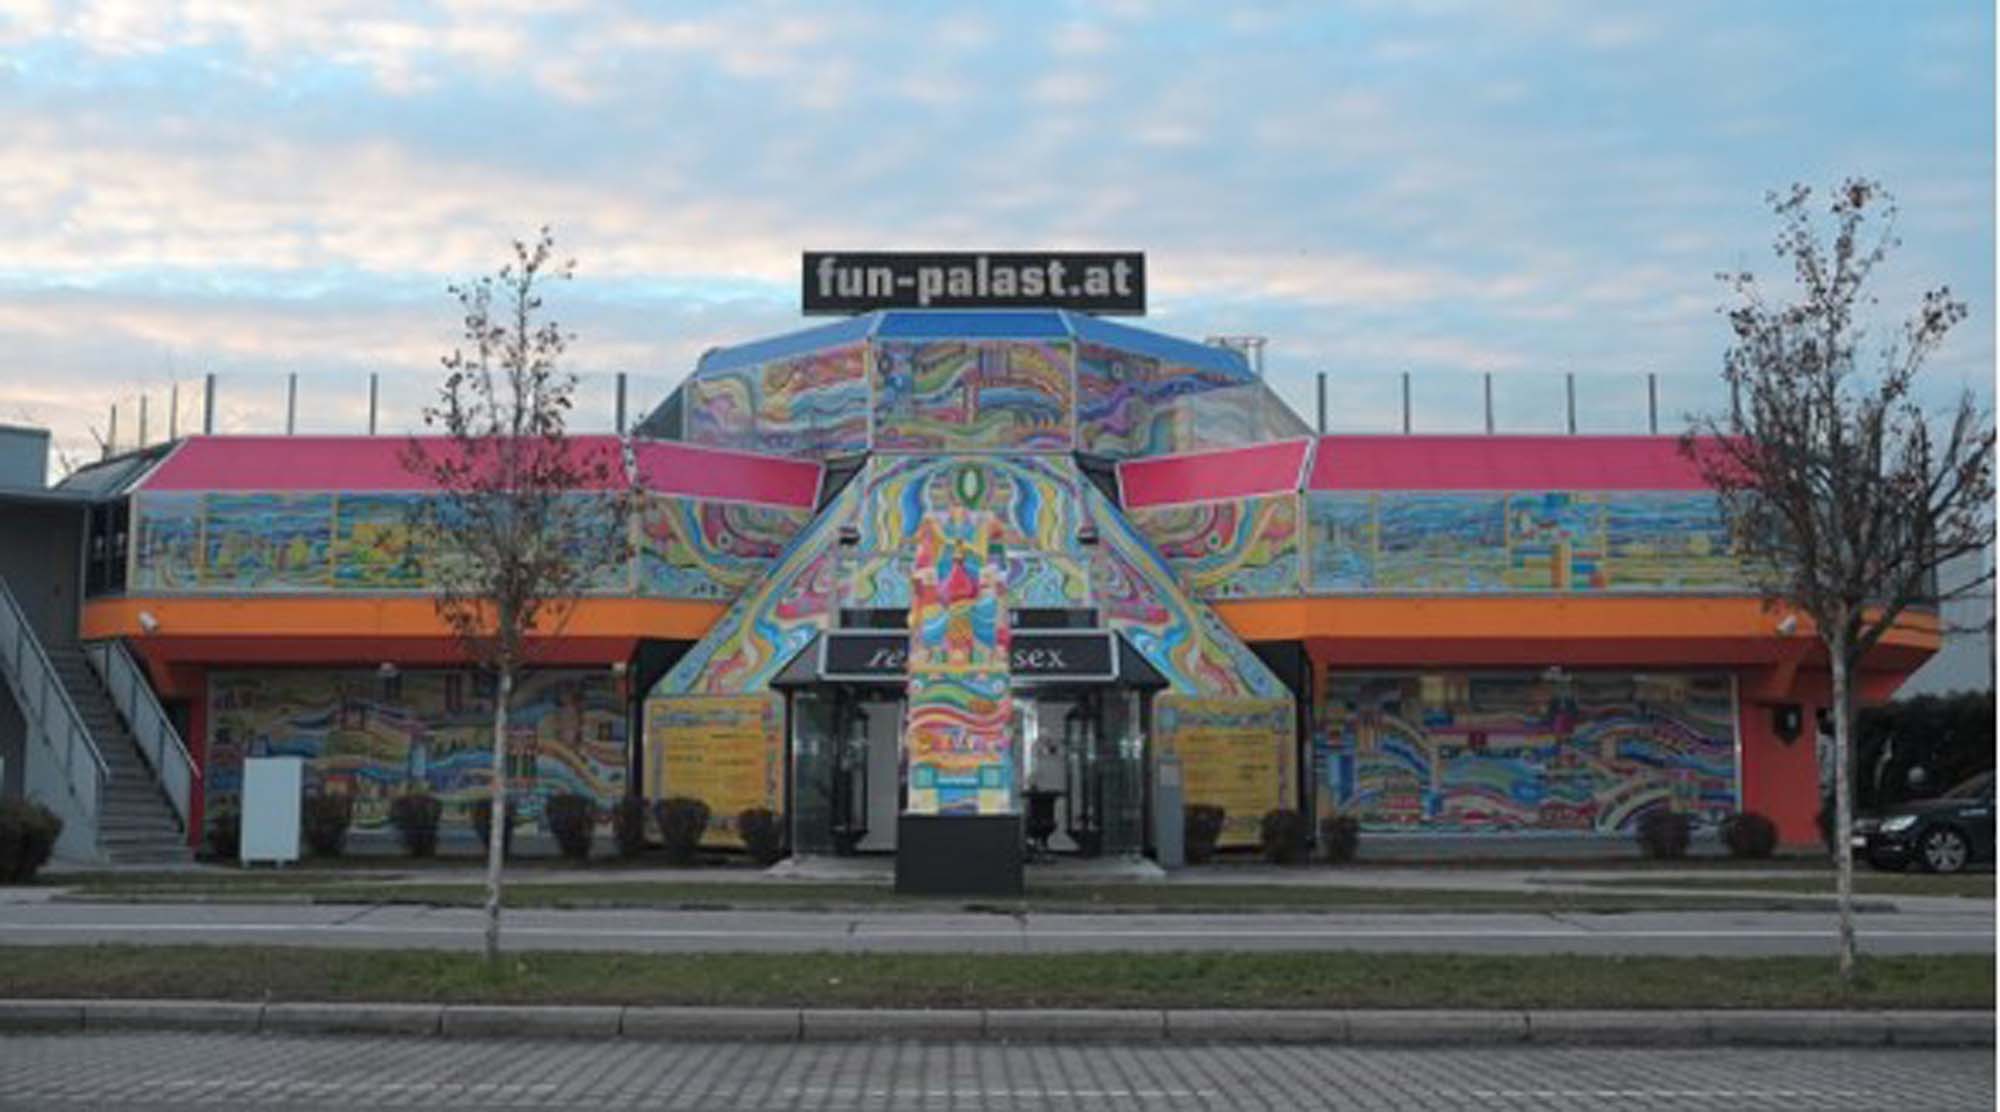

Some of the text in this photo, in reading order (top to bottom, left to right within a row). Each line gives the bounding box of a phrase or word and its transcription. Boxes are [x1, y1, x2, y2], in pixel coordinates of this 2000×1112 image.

[817, 257, 1132, 305] fun-palast.at
[865, 648, 1068, 668] re sex
